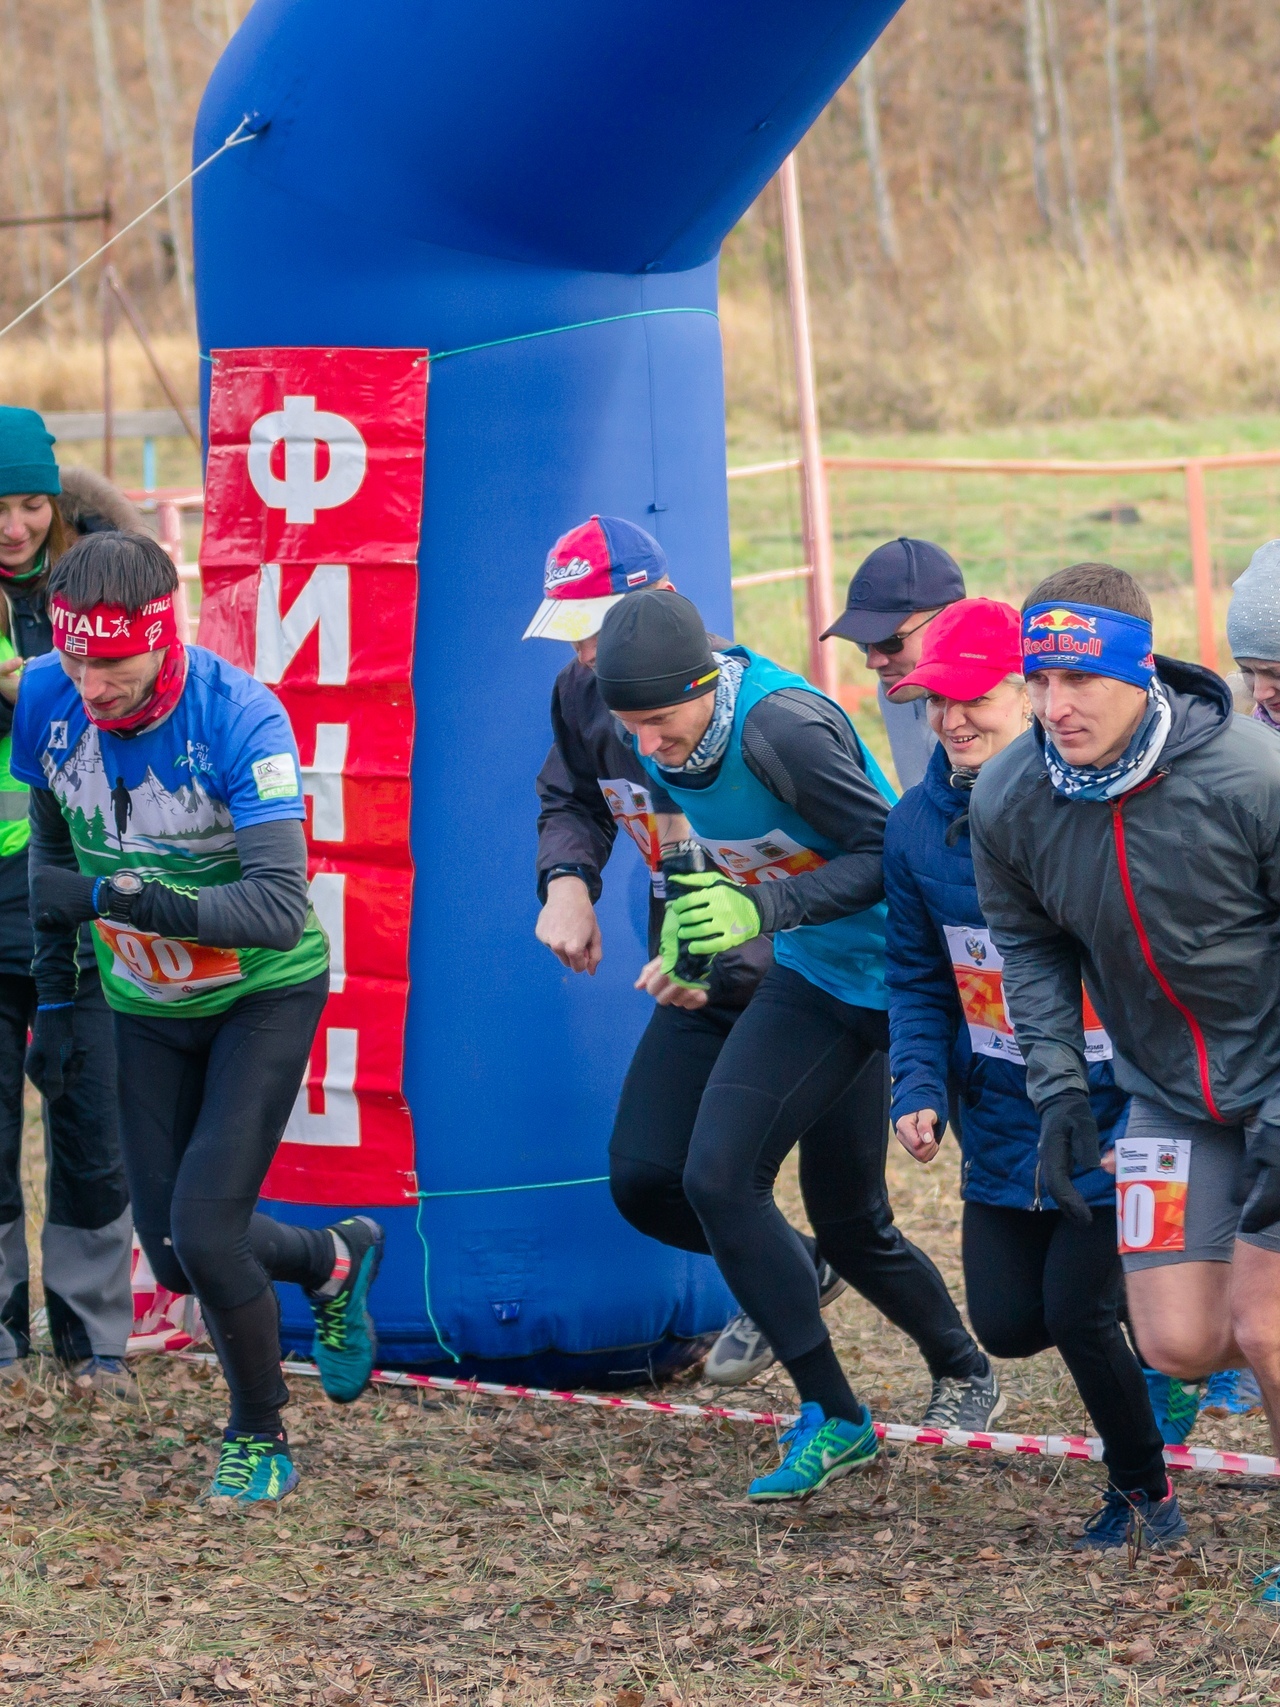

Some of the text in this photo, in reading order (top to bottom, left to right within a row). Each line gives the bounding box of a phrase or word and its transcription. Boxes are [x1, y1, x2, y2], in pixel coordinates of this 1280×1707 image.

[52, 602, 111, 638] VITAL
[1023, 633, 1102, 657] Red Bull
[116, 933, 193, 980] 90
[1116, 1183, 1156, 1249] 0
